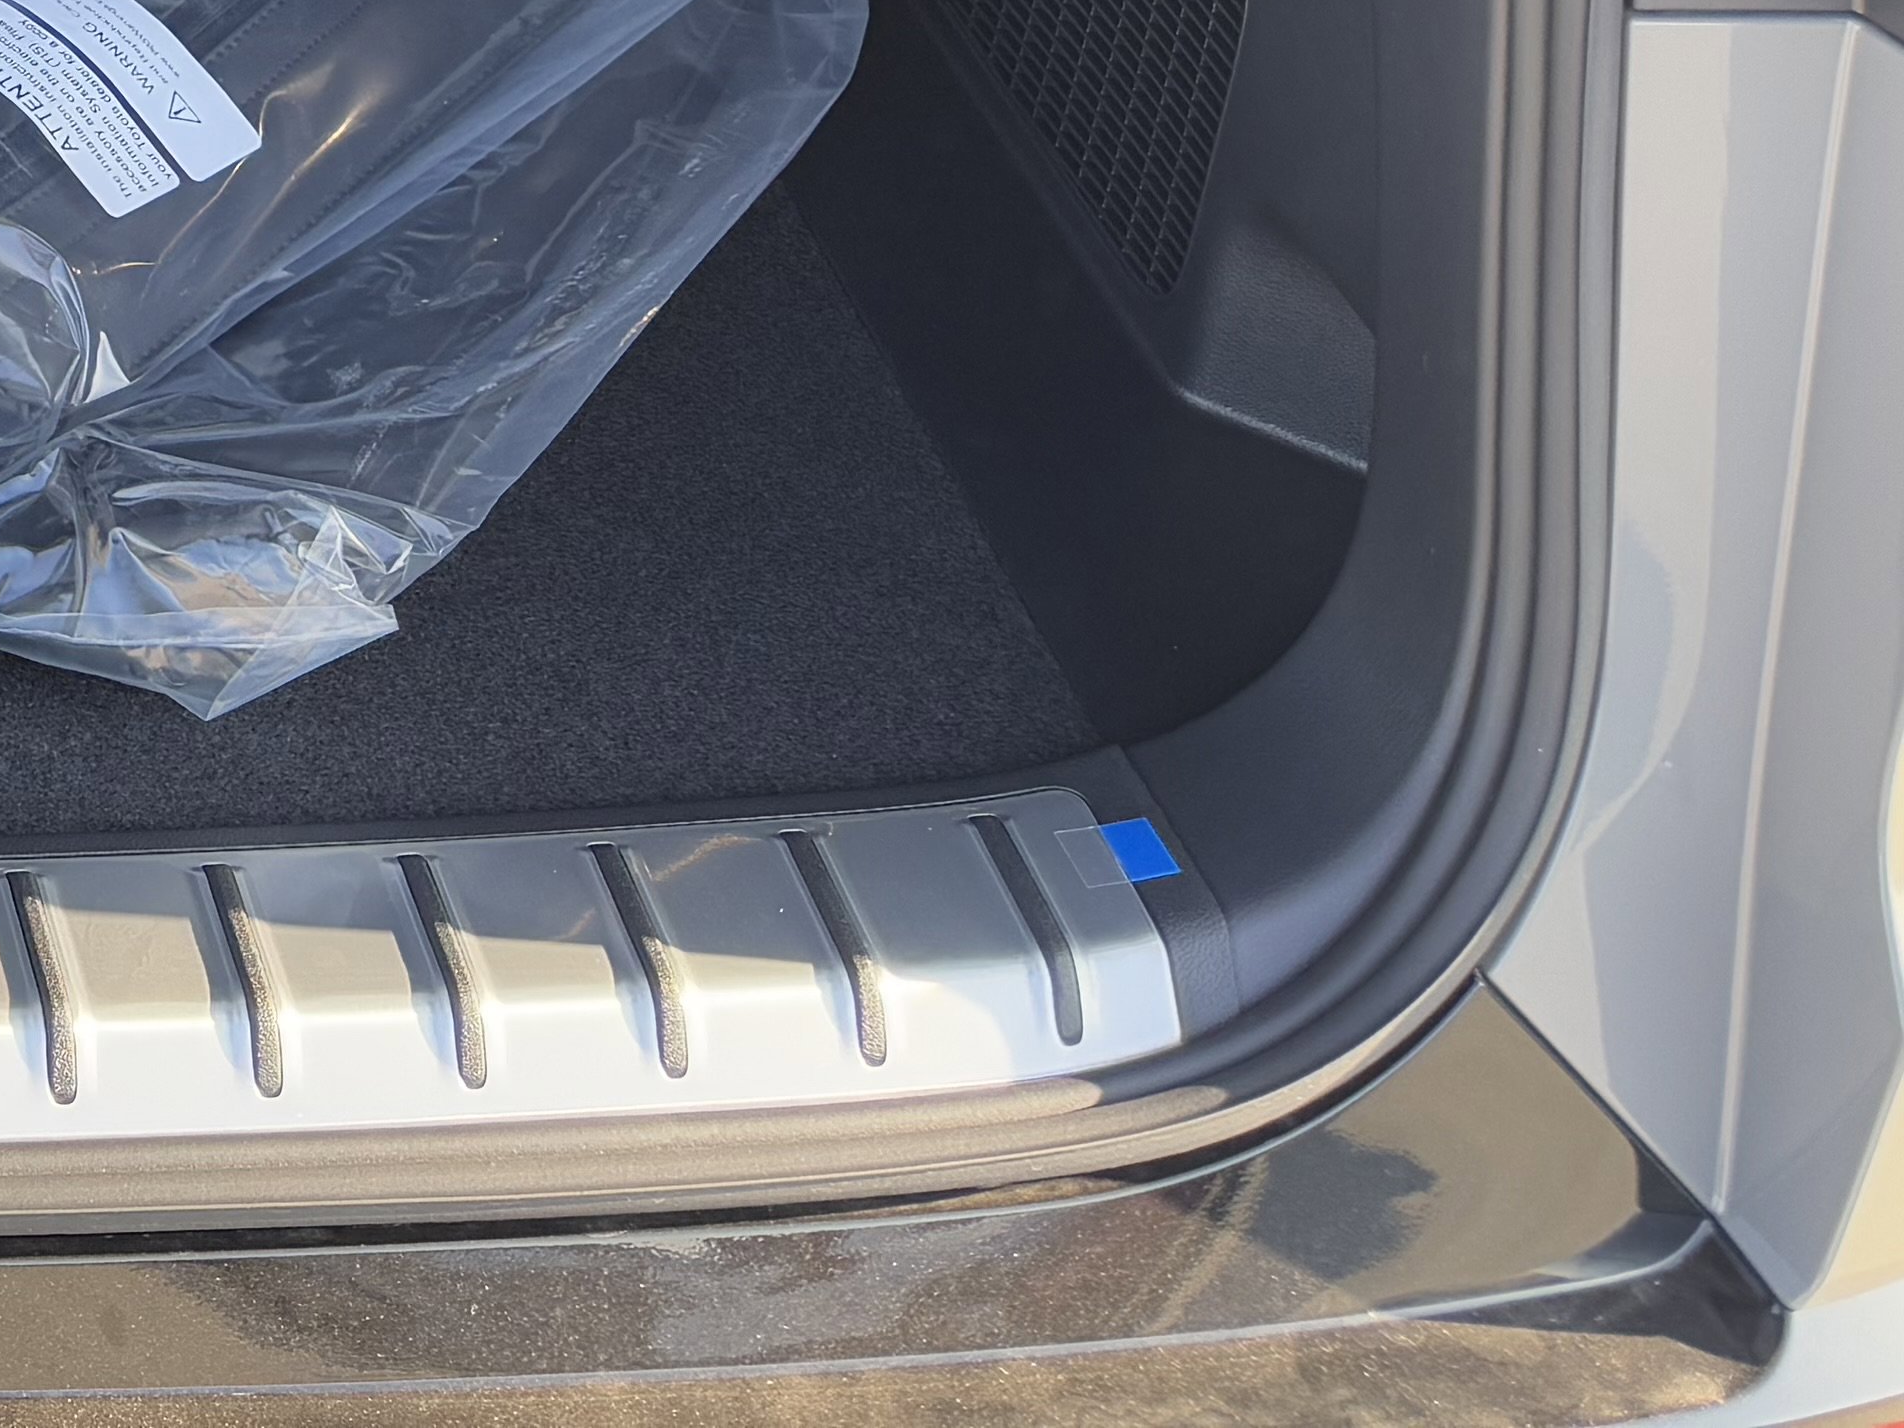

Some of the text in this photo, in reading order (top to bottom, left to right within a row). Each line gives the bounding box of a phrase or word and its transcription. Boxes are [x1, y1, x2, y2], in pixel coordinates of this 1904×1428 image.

[58, 49, 75, 65] for
[40, 68, 60, 86] the
[60, 69, 101, 114] System
[75, 66, 111, 103] dealer
[76, 106, 94, 126] are
[111, 106, 146, 150] Toyota
[57, 104, 112, 173] installation
[94, 130, 147, 192] accessory
[146, 153, 172, 180] your
[112, 176, 132, 198] The
